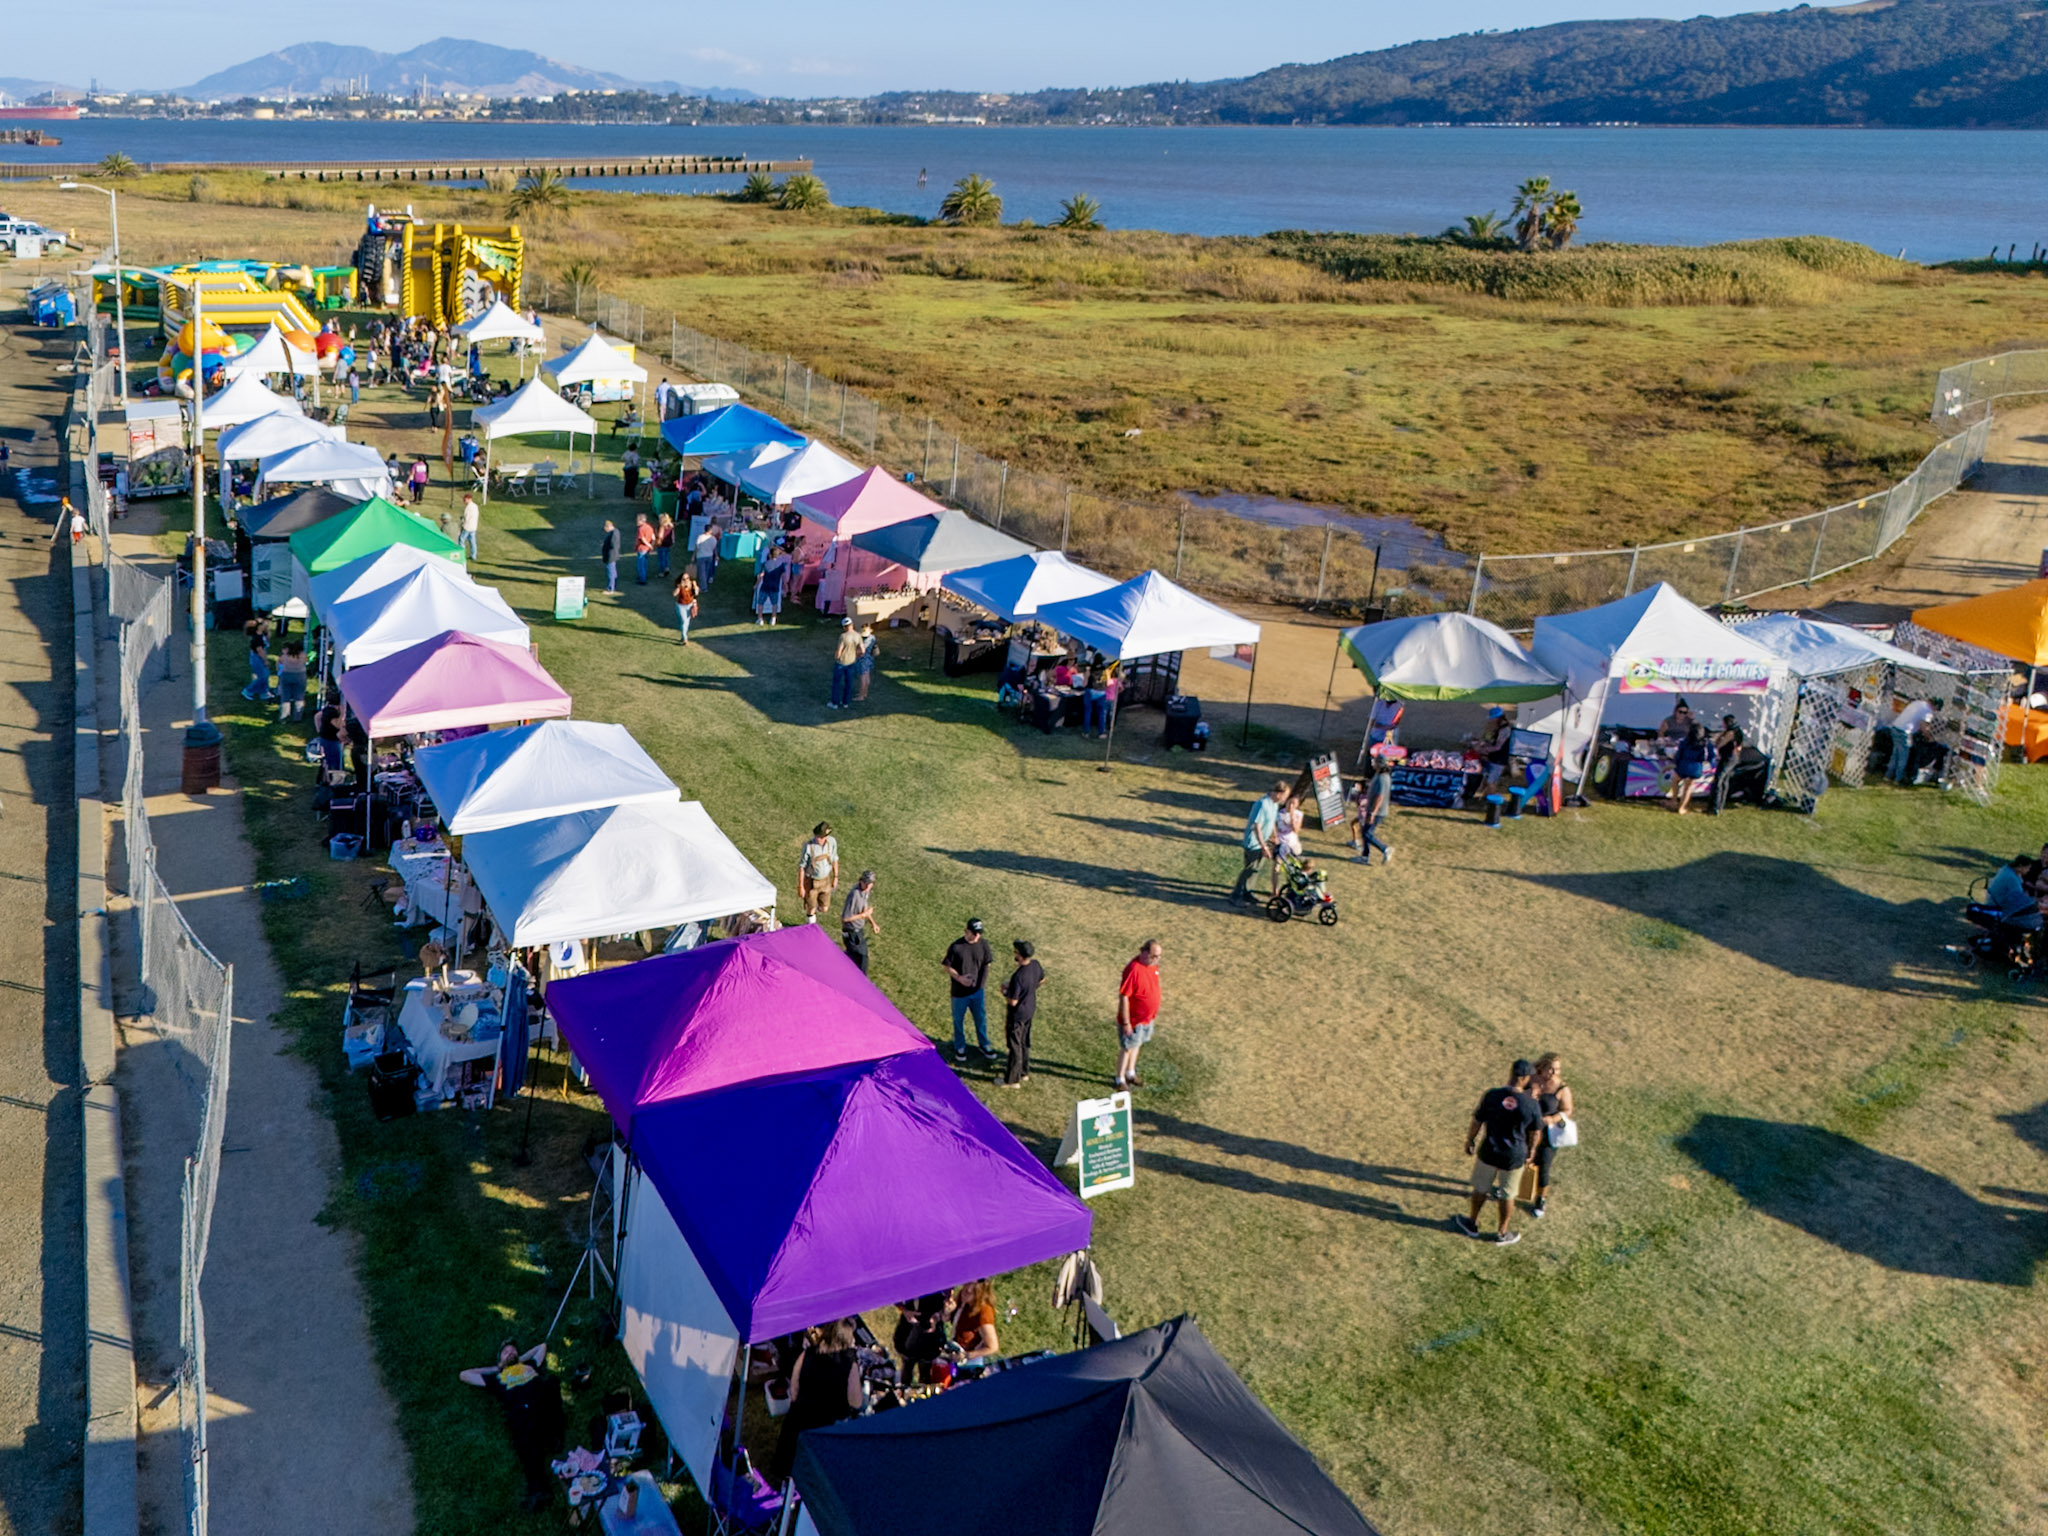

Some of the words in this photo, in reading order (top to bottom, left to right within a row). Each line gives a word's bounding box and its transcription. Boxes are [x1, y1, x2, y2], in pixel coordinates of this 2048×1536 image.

[1661, 664, 1713, 680] GOURMET
[1717, 664, 1767, 680] COOKIES
[1391, 770, 1463, 791] SKIP'S
